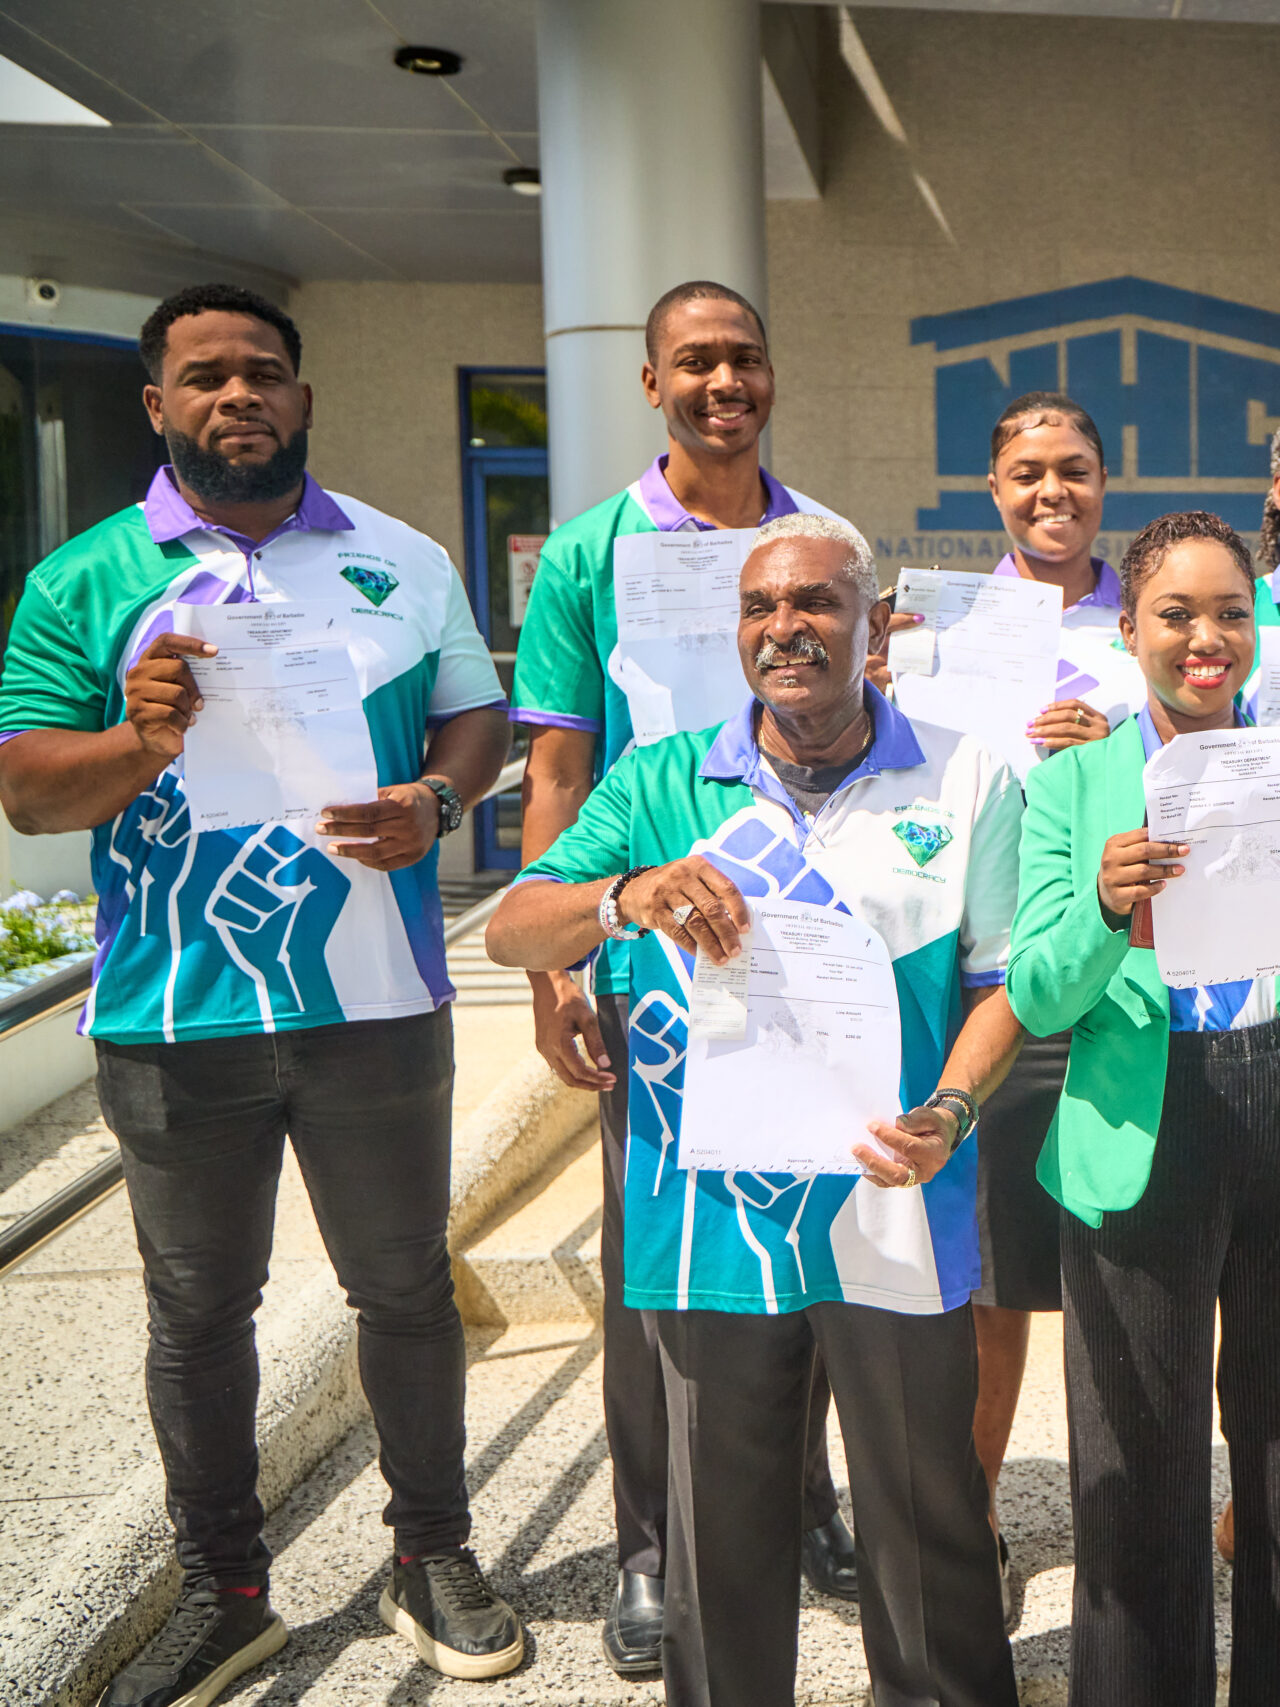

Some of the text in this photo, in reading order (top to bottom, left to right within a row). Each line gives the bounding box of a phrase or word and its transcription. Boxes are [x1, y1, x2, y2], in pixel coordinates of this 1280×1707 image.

[1200, 741, 1236, 750] Government
[762, 911, 798, 920] Government
[820, 918, 844, 928] Barbados
